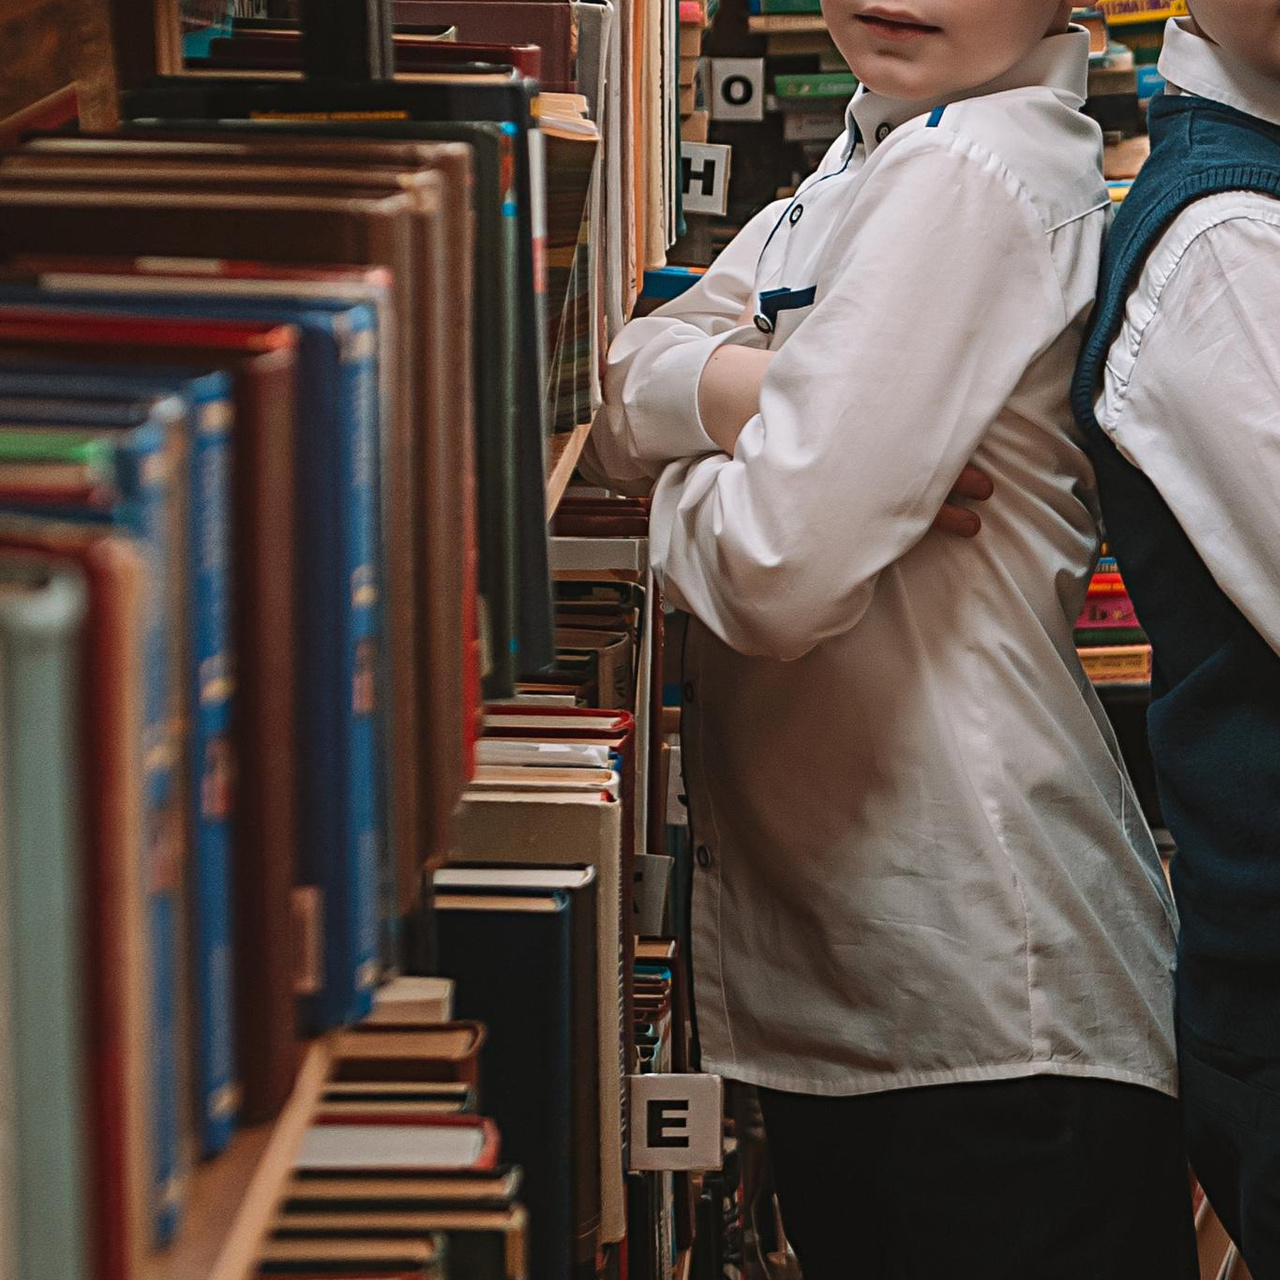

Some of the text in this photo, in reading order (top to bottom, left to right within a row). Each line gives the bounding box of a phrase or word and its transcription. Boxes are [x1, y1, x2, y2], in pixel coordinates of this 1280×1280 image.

[720, 74, 754, 106] О
[681, 157, 716, 196] Н
[646, 1099, 690, 1148] Е
